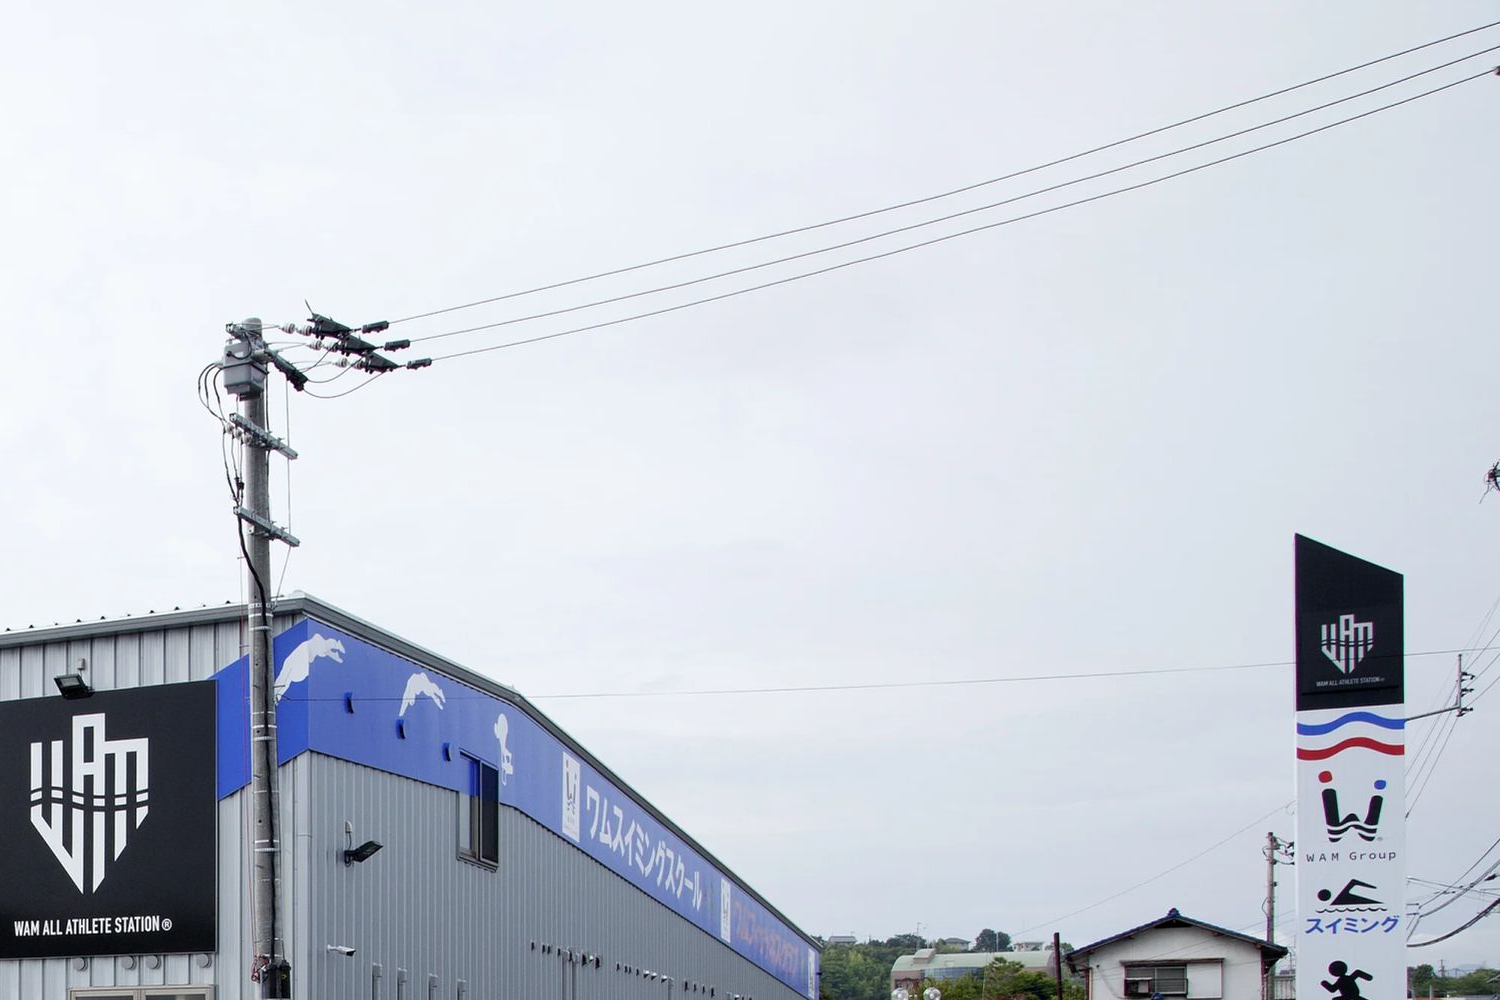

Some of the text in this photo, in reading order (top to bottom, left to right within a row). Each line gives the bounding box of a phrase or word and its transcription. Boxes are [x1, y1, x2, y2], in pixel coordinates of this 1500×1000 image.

[586, 784, 703, 912] ワムスイミングスクール
[1306, 851, 1397, 862] WAM Group
[14, 920, 40, 937] WAM
[42, 919, 63, 936] ALL
[65, 917, 112, 935] ATHLETE
[1305, 915, 1400, 935] スイミング
